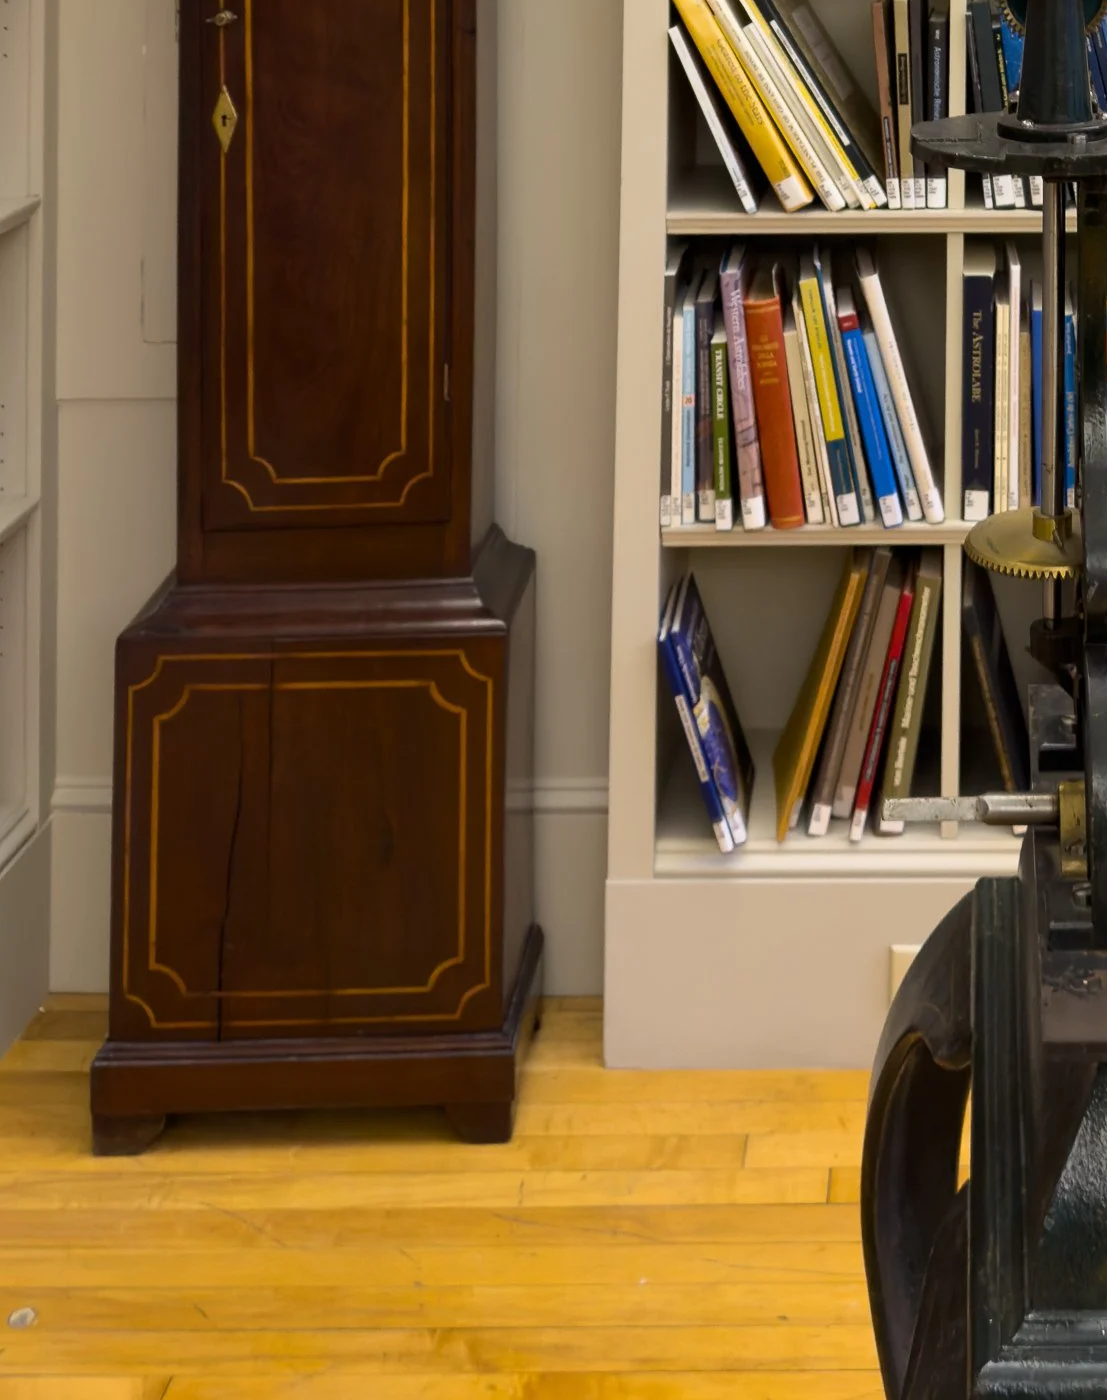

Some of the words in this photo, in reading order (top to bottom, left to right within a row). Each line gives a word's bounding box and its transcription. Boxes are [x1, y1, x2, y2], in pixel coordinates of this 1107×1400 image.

[933, 46, 941, 96] Astronomische
[729, 289, 743, 332] Western
[972, 310, 982, 329] The
[715, 349, 723, 385] TRANSIT
[732, 335, 748, 390] Astrolabes
[971, 331, 983, 402] ASTROLABE
[716, 388, 724, 419] CIRCLE
